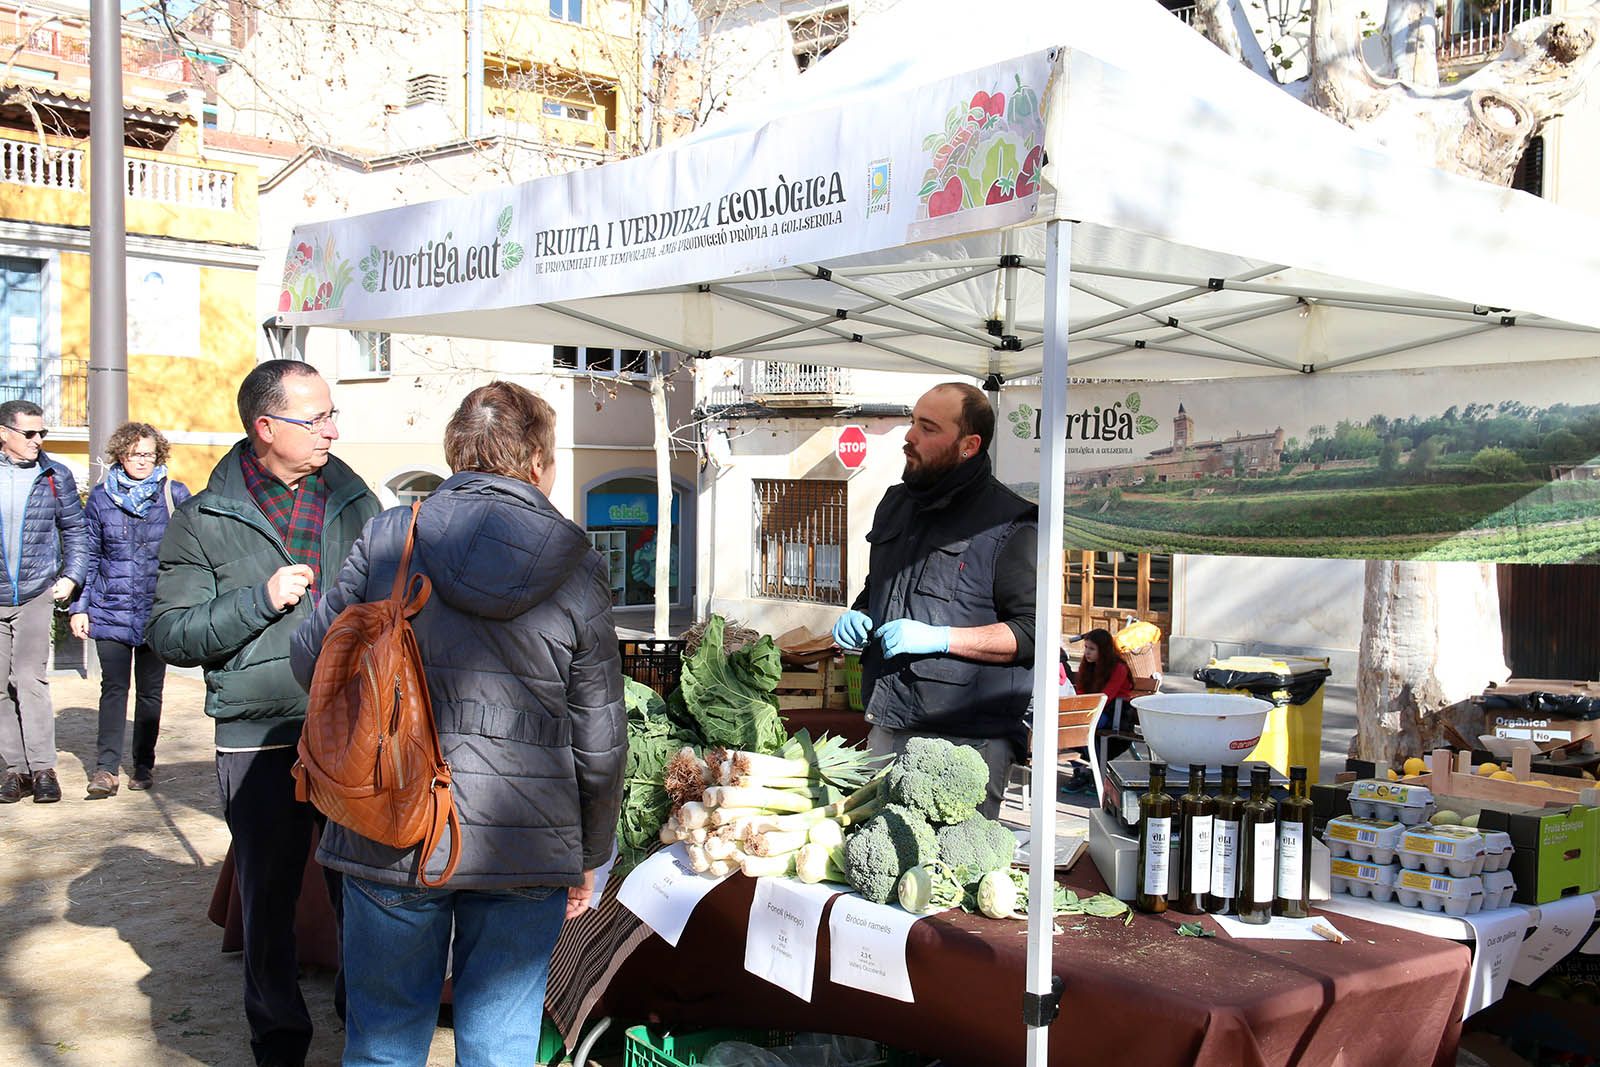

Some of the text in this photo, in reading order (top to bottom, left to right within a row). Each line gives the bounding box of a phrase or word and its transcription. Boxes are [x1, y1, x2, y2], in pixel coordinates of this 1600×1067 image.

[534, 224, 600, 258] FRUITA
[606, 221, 615, 249] I
[619, 201, 712, 247] VERDURA
[716, 171, 847, 226] ECOLÒGICA
[770, 222, 779, 237] A
[781, 210, 843, 235] COLLSEROLA
[839, 441, 867, 453] STOP
